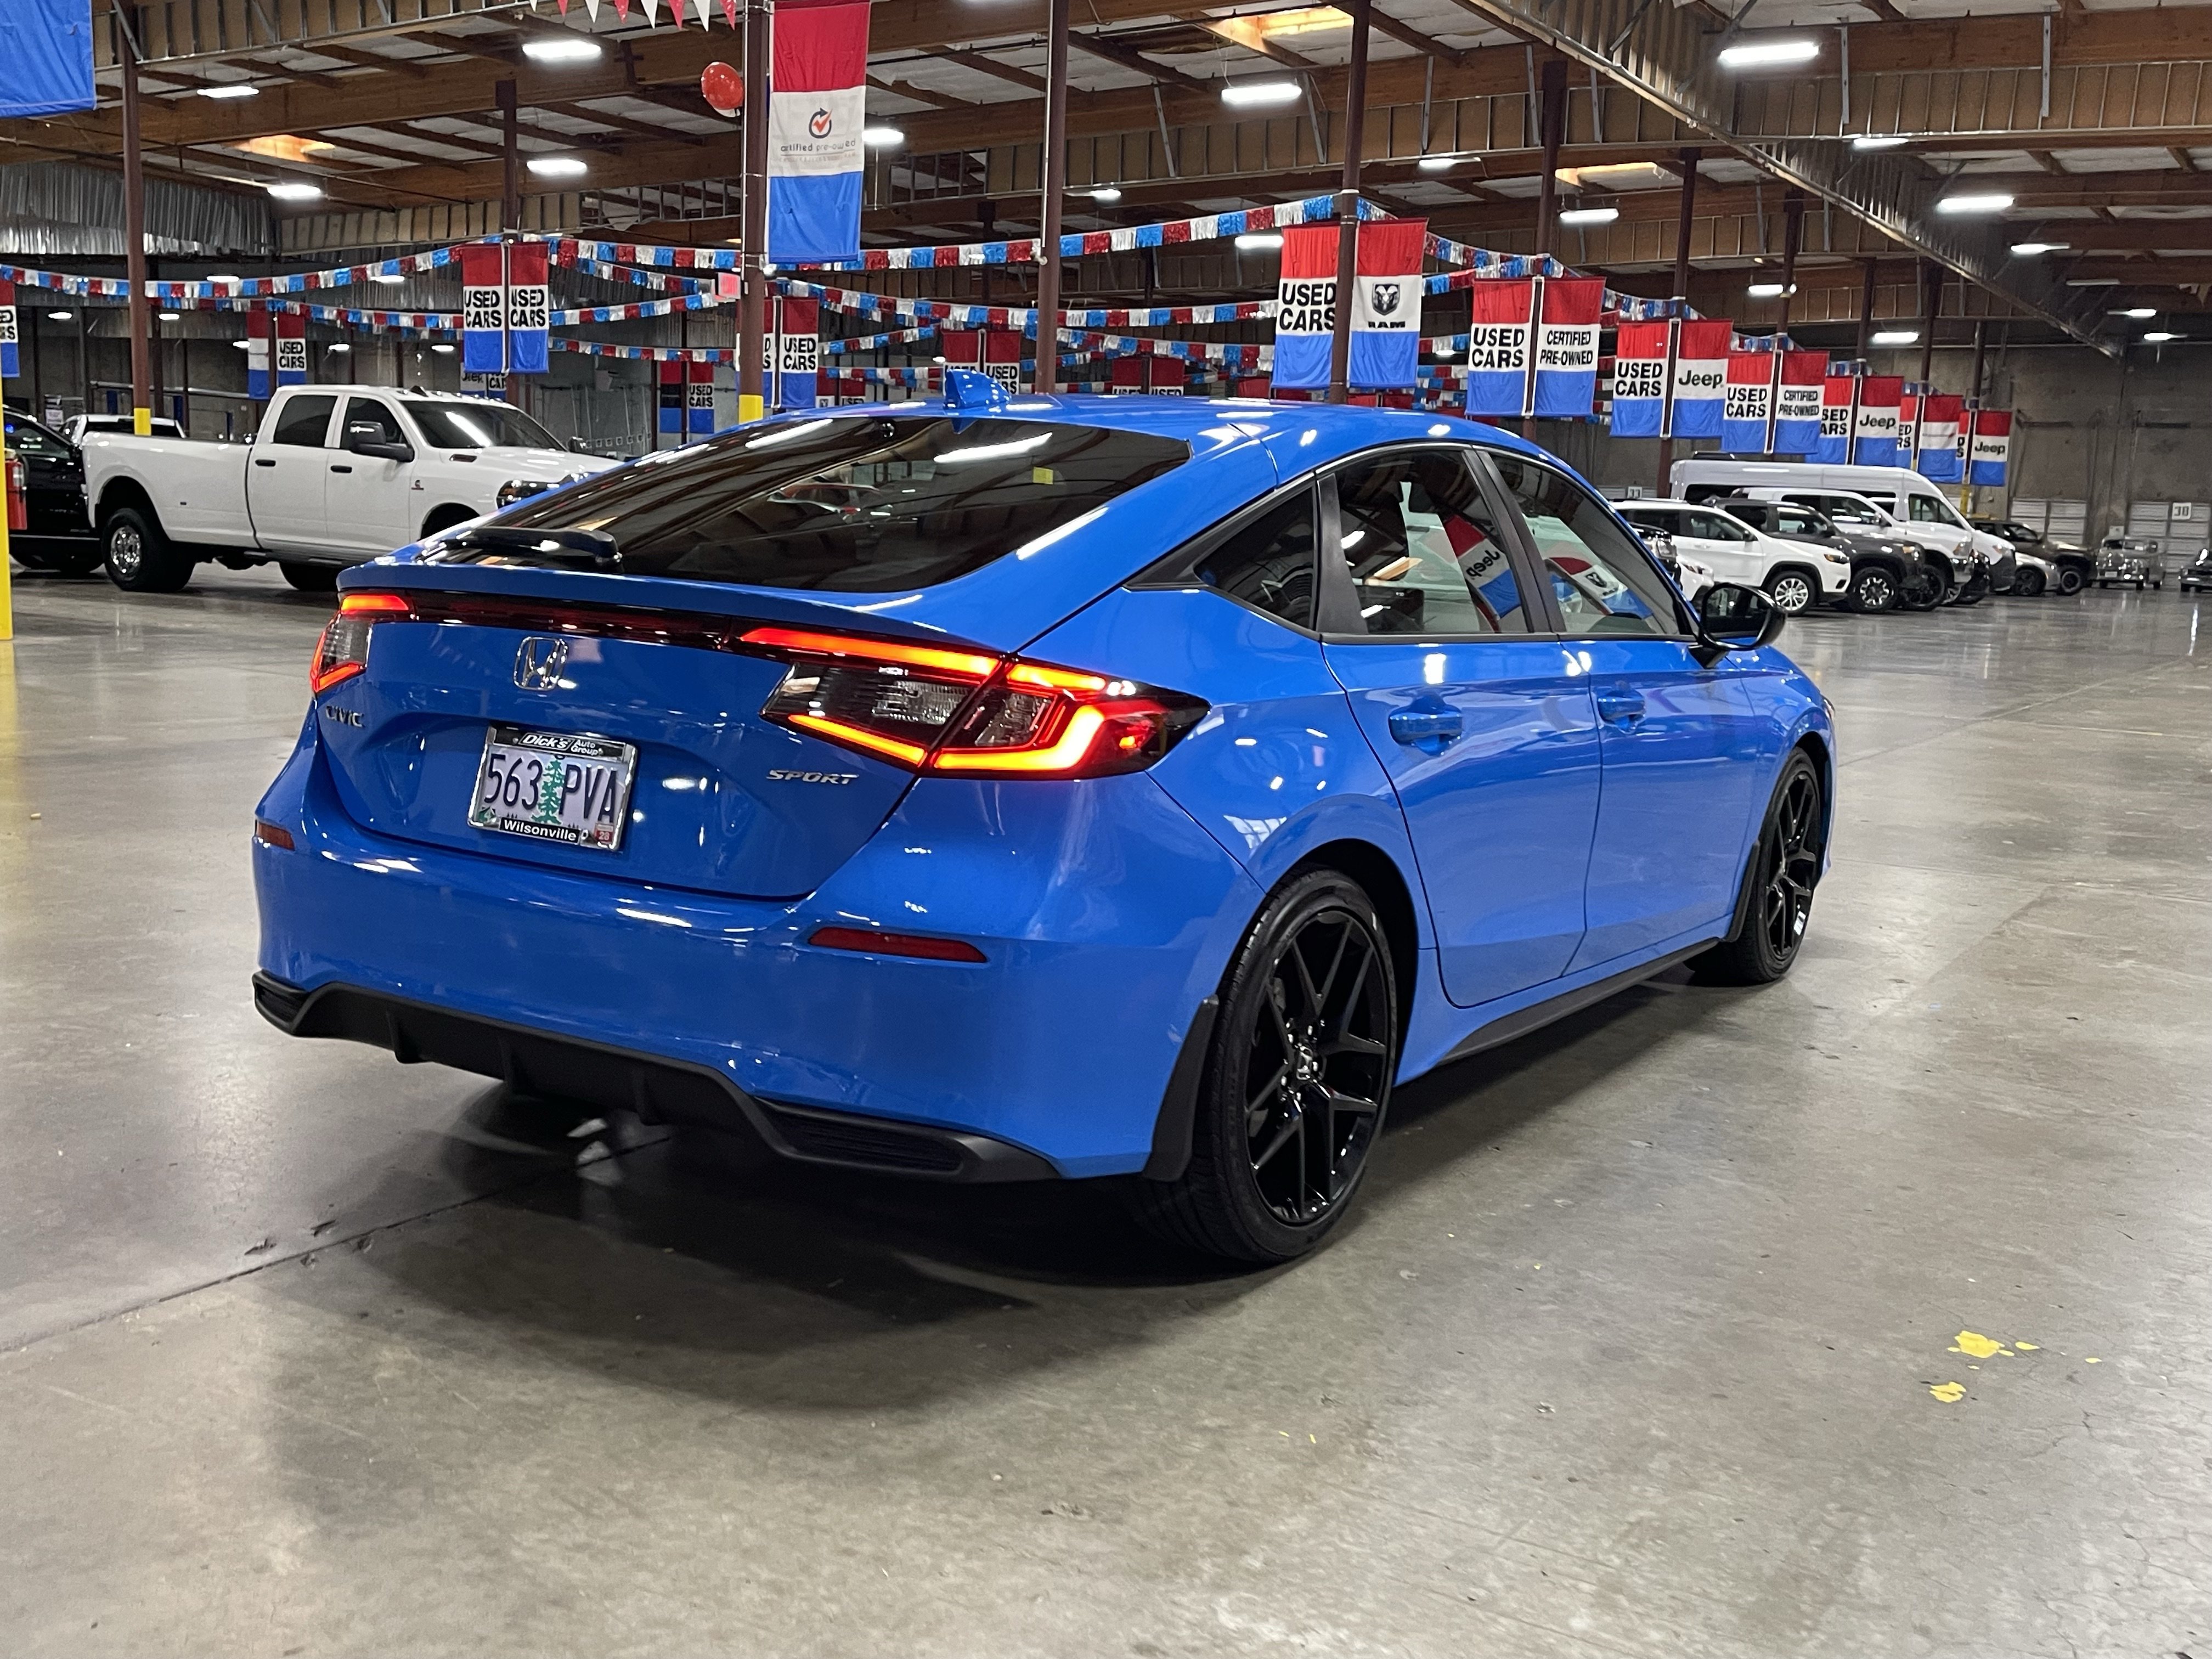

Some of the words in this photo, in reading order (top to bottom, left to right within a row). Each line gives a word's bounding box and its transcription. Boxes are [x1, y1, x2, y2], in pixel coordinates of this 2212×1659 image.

[465, 290, 500, 308] USED
[511, 289, 544, 307] USED
[1282, 283, 1336, 306] USED
[466, 310, 501, 328] CARS
[510, 309, 545, 327] CARS
[1279, 308, 1335, 331] CARS
[784, 337, 816, 353] USED
[1474, 328, 1524, 347] USED
[1547, 330, 1591, 346] CERTIFIED
[279, 341, 303, 354] USED
[783, 354, 816, 370] CARS
[1472, 348, 1523, 368] CARS
[1540, 349, 1593, 366] PRE-OWNED
[986, 365, 1018, 379] USED
[1618, 362, 1662, 379] USED
[1678, 370, 1723, 388] Jeep
[689, 385, 713, 395] USED
[1615, 380, 1661, 396] CARS
[1728, 387, 1767, 402] USED
[1784, 390, 1818, 401] CERTIFIED
[1726, 403, 1766, 417] CARS
[1779, 405, 1819, 416] PRE-OWNED
[1822, 409, 1848, 421] SED
[1821, 423, 1847, 435] ARS
[1860, 414, 1896, 430] Jeep
[1975, 442, 2005, 455] Jeep
[326, 706, 364, 727] CIVIC
[523, 735, 568, 748] Dick's
[574, 740, 595, 748] Auto
[571, 746, 599, 755] Group
[766, 770, 859, 784] SPORT
[484, 754, 543, 810] 563
[558, 764, 617, 822] PVA
[503, 820, 577, 841] Wilsonville
